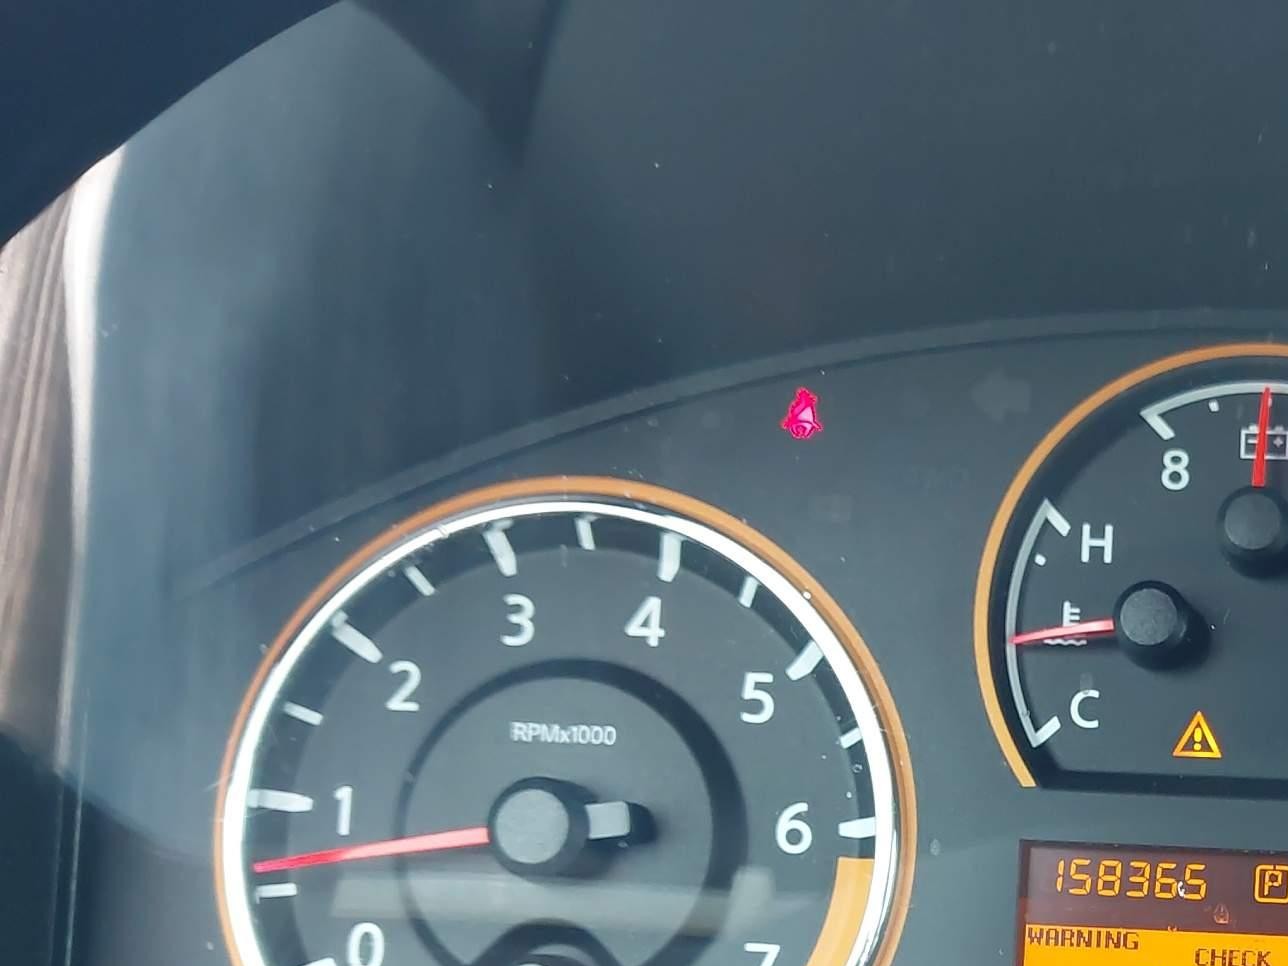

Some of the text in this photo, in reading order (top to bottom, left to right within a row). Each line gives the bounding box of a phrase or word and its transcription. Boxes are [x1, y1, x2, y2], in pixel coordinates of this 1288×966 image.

[1160, 449, 1190, 491] 8
[1081, 523, 1114, 564] H
[501, 595, 536, 647] 3
[625, 596, 665, 647] 4
[386, 660, 421, 712] 2
[740, 671, 775, 724] 5
[1069, 689, 1100, 729] C
[333, 785, 354, 836] 1
[774, 802, 814, 855] 6
[1055, 857, 1208, 900] 158365
[1264, 869, 1283, 897] P
[1027, 927, 1140, 951] WARNING
